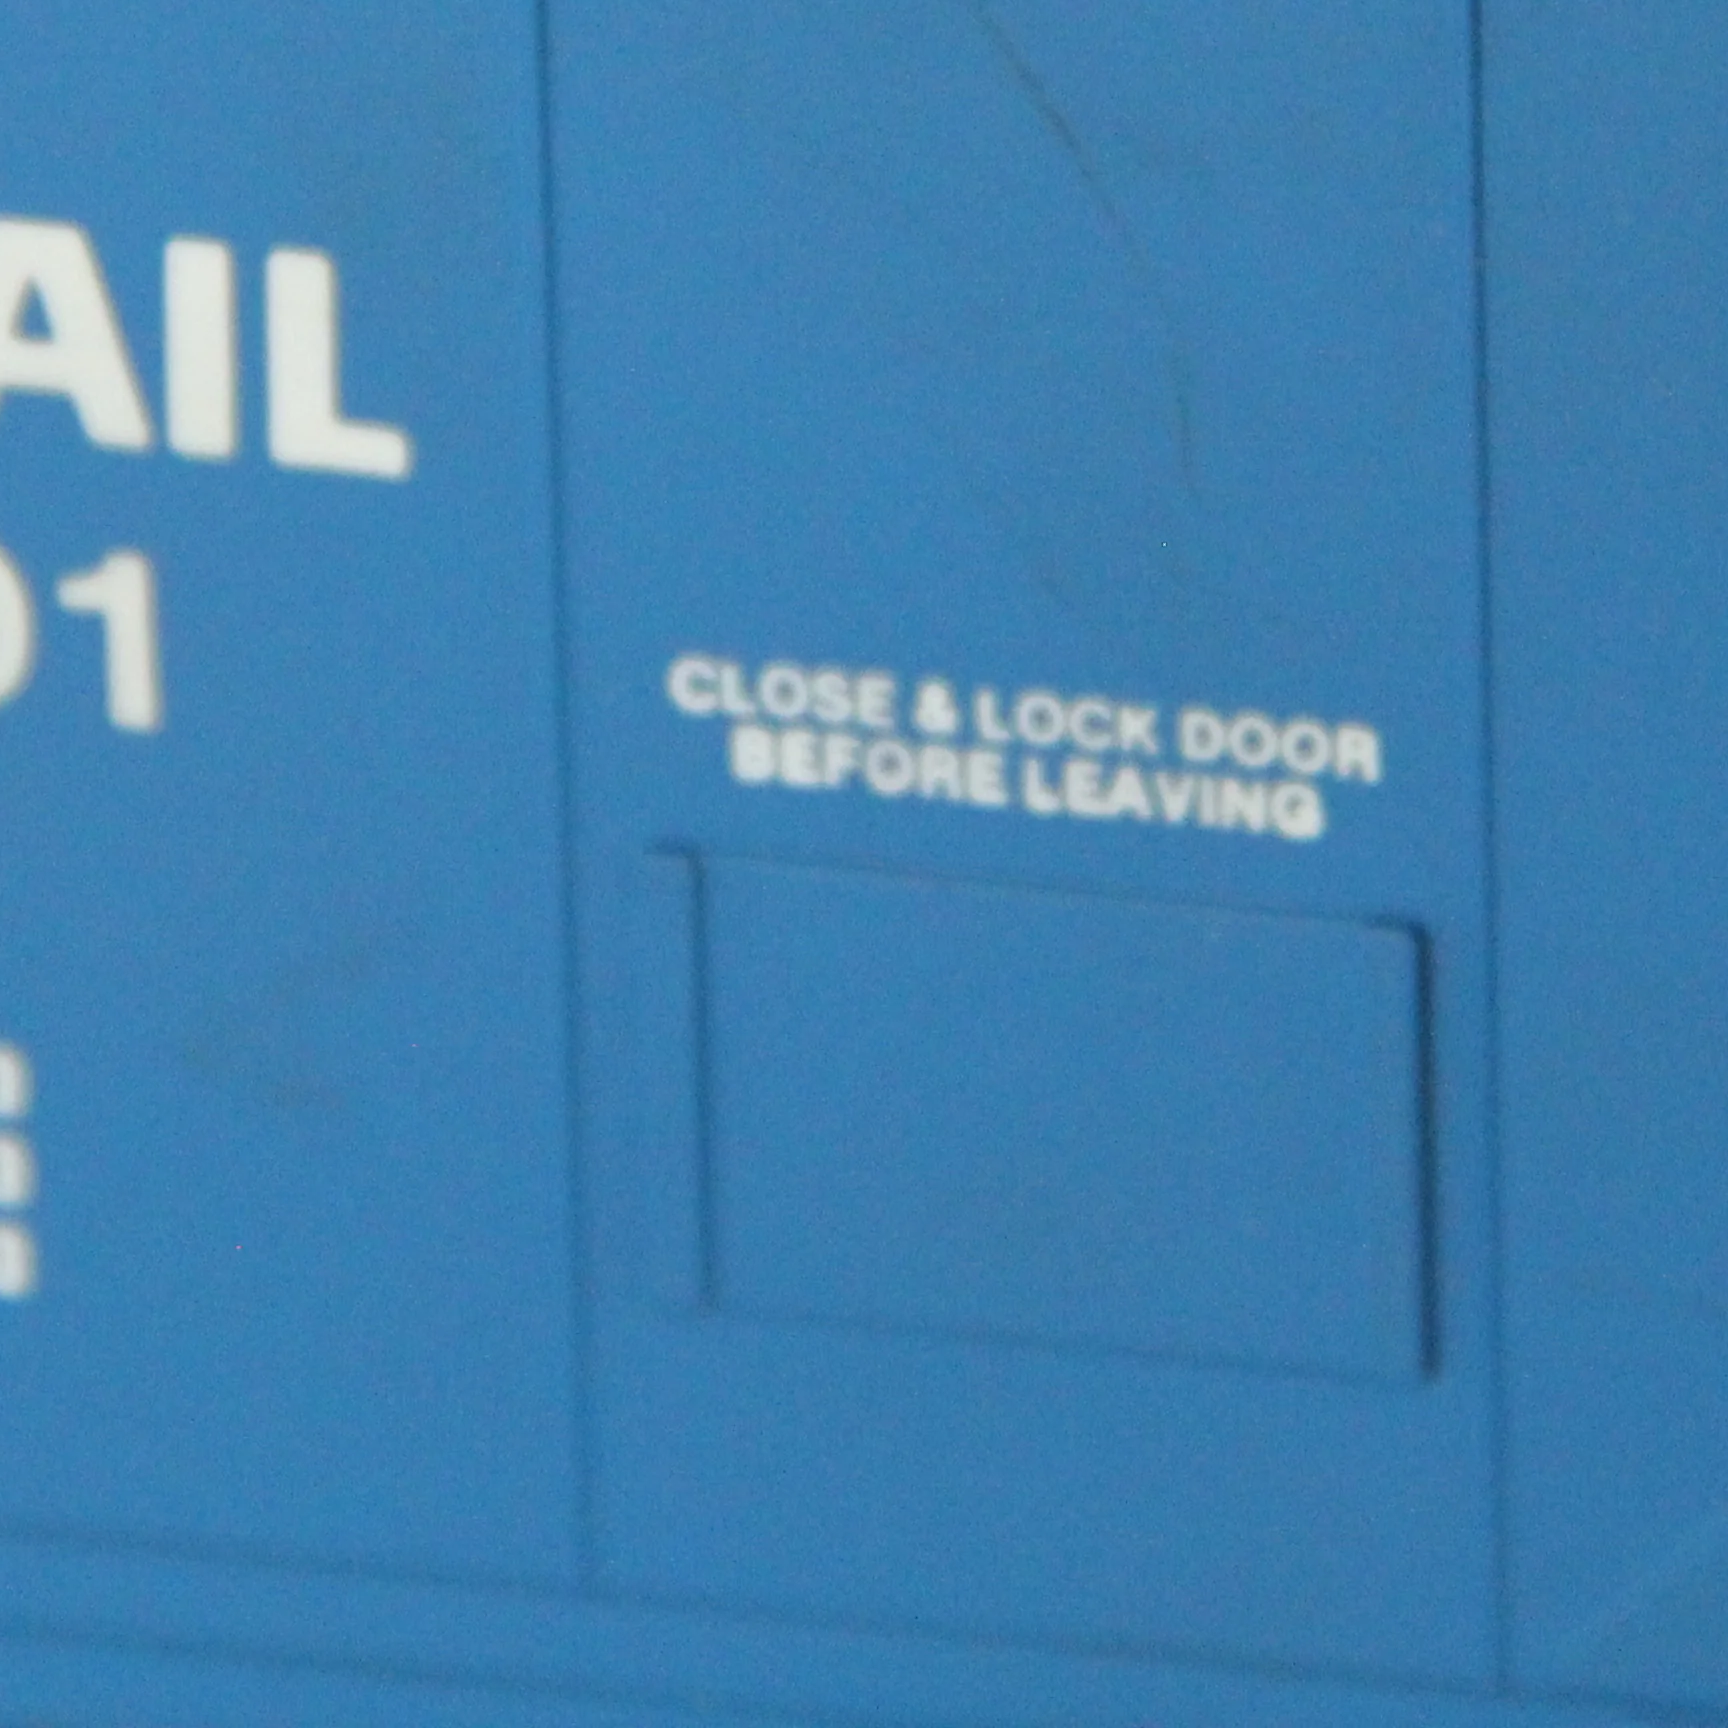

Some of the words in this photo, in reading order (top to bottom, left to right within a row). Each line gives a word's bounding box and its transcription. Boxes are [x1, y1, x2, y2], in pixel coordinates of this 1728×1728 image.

[666, 654, 896, 735] CLOSE
[912, 679, 961, 739] &
[973, 689, 1159, 755] LOCK
[1178, 708, 1381, 783] DOOR
[729, 722, 1010, 807] BEFORE
[1021, 755, 1325, 840] LEAVING
